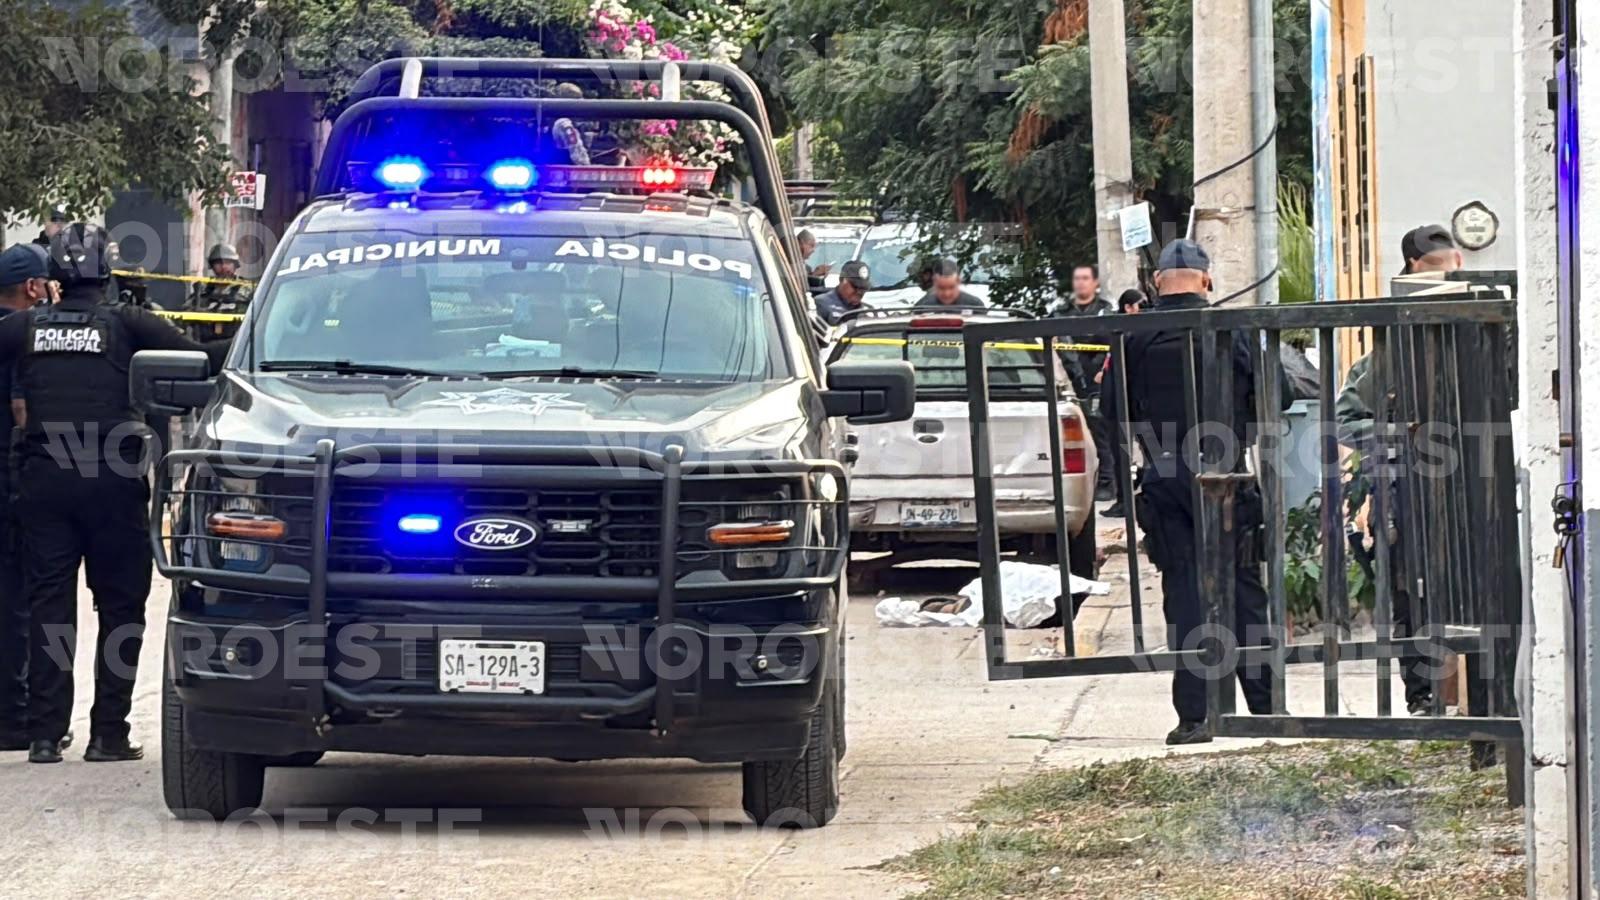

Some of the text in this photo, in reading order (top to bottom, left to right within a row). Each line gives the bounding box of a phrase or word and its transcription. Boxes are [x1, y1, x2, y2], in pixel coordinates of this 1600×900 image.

[35, 327, 101, 342] POLICÍA
[34, 340, 101, 353] MUNICIPAL
[469, 523, 520, 544] Ford
[445, 654, 540, 677] SA-129A-3
